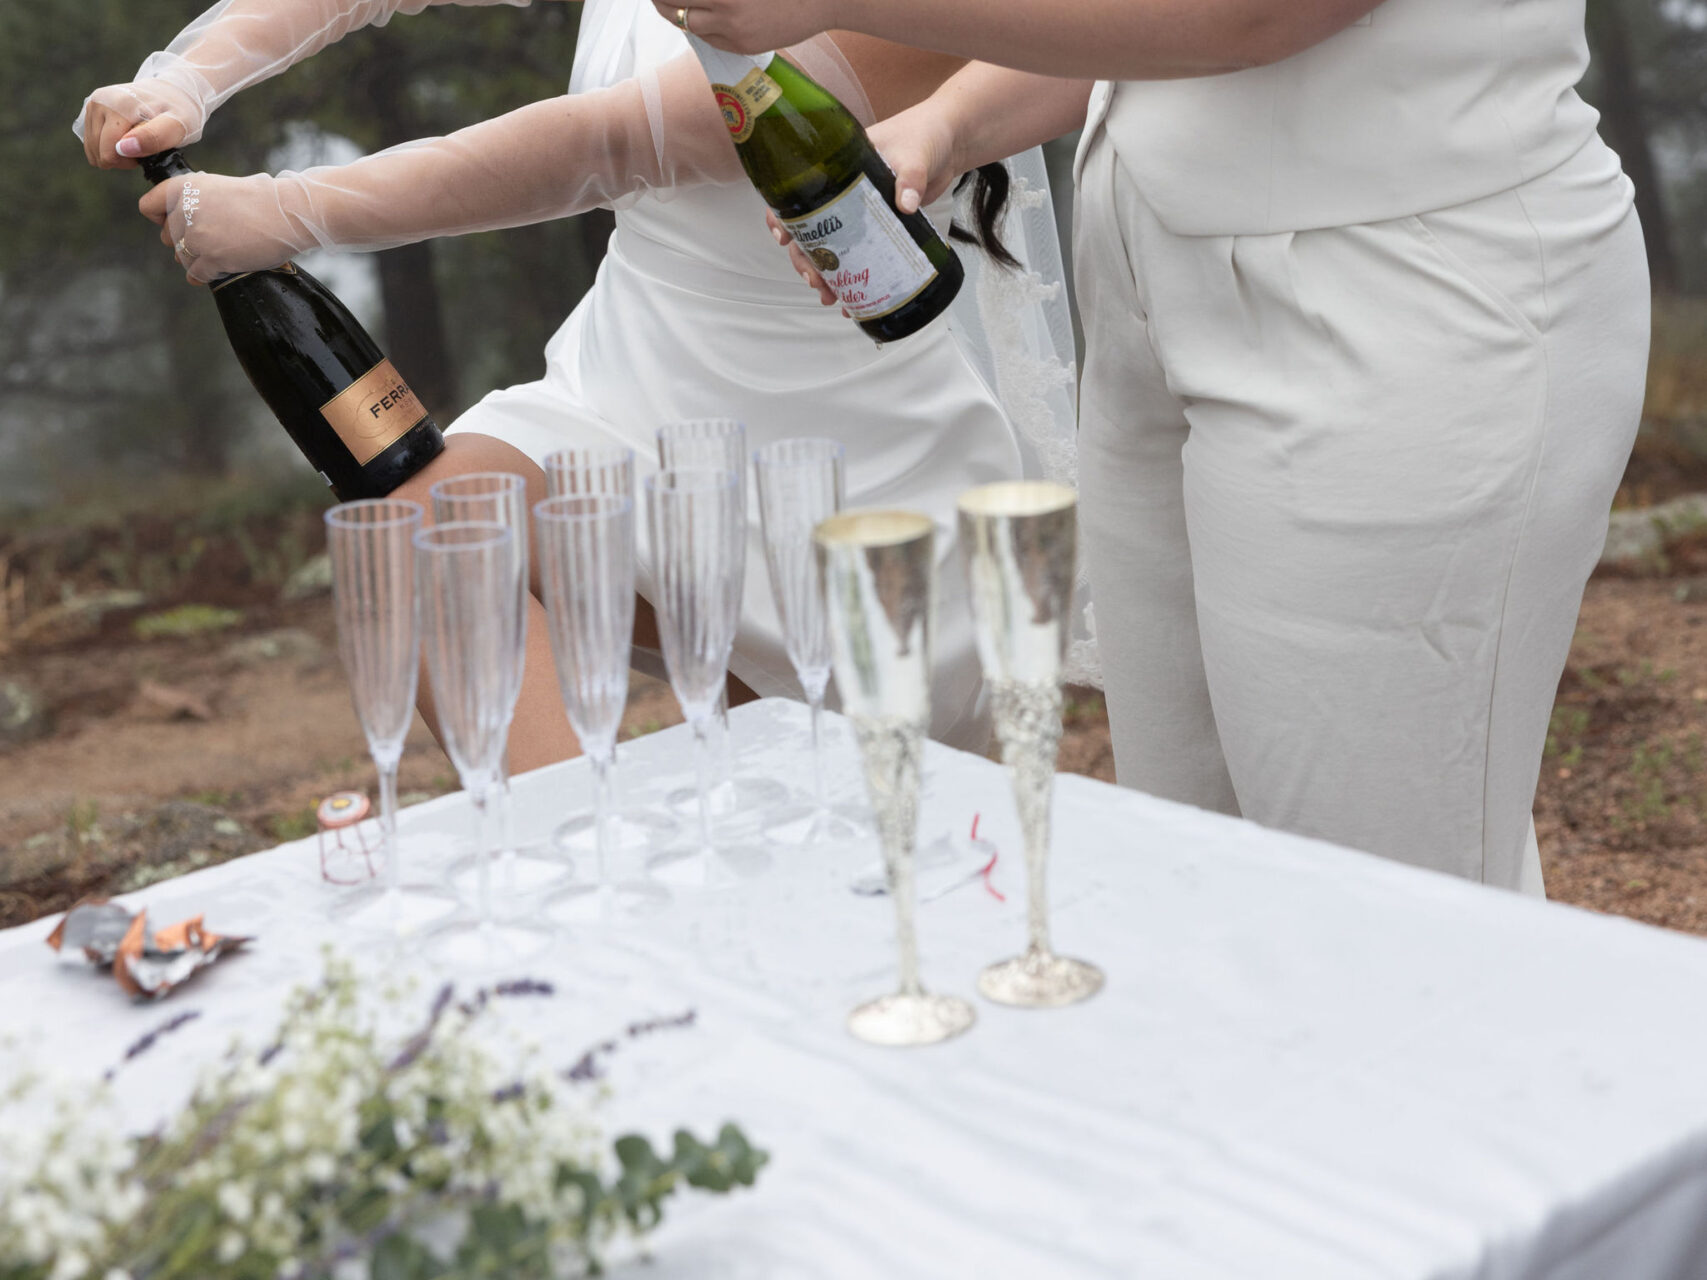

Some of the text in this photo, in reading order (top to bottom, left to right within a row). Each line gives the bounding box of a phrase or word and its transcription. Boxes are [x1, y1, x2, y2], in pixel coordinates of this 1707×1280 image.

[190, 188, 200, 215] R & L
